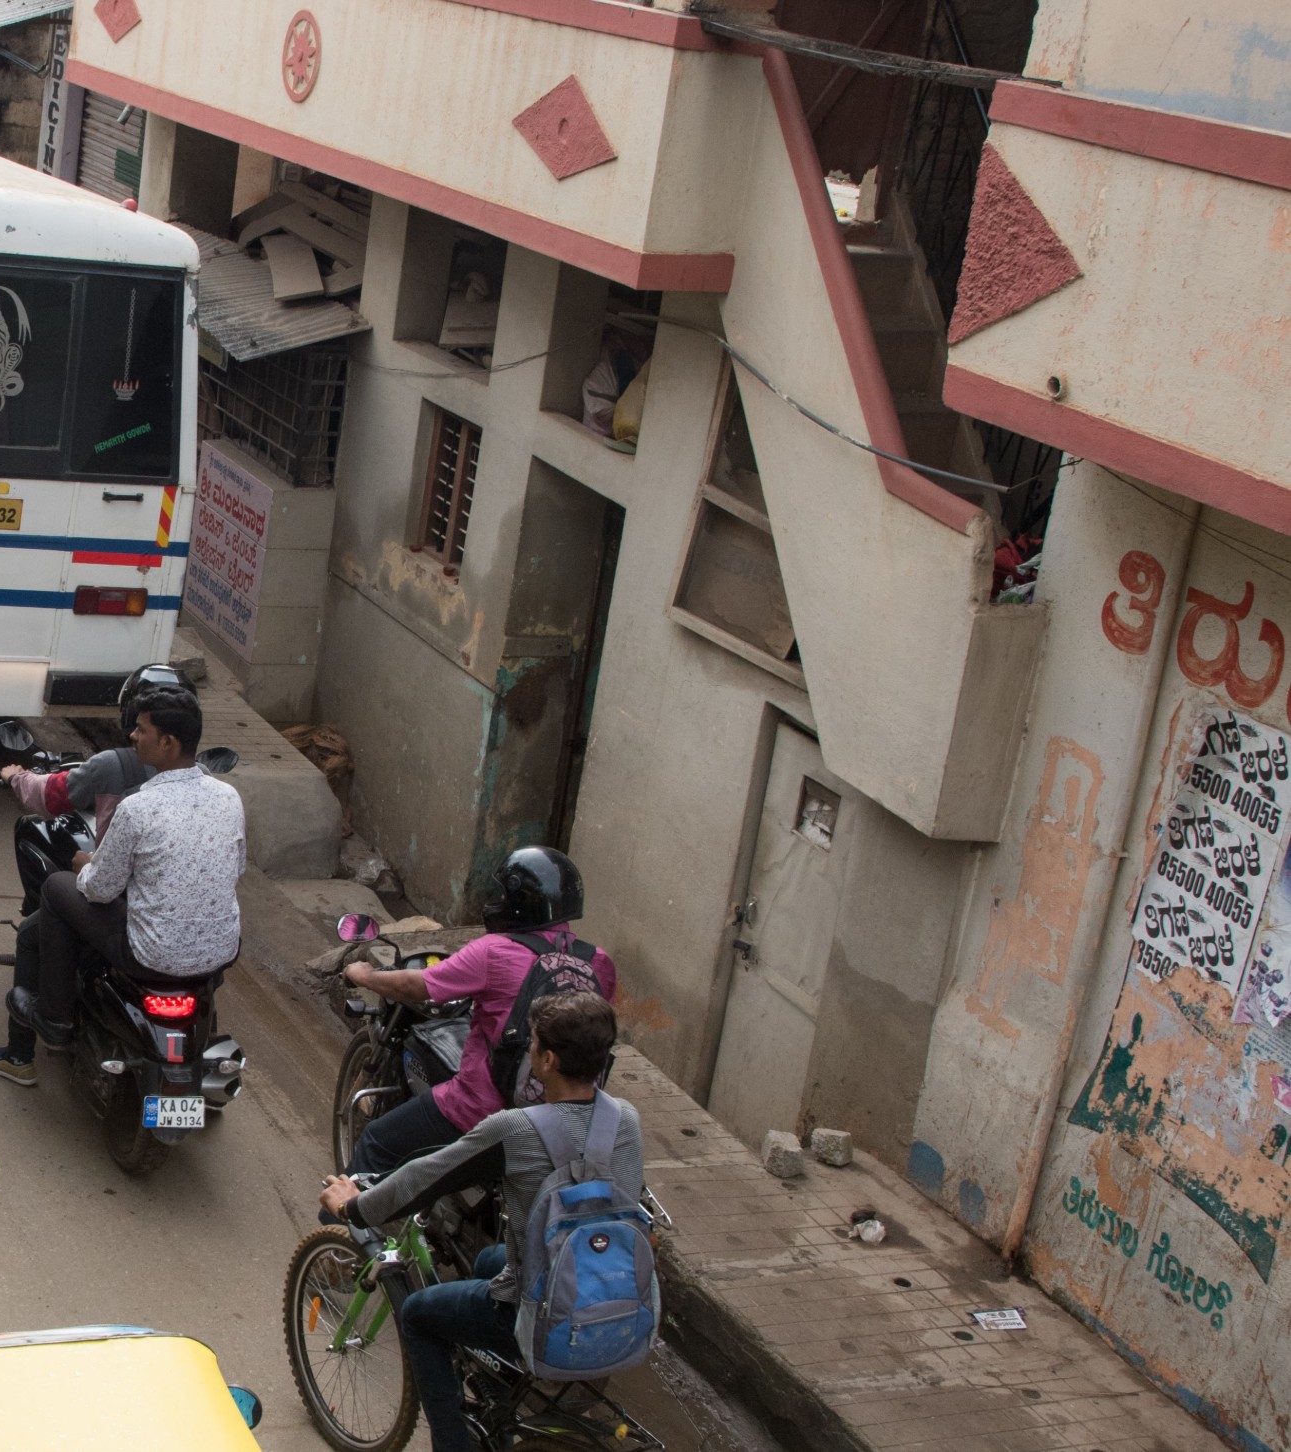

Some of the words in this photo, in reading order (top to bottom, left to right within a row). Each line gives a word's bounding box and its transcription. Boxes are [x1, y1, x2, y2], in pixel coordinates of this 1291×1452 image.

[126, 422, 152, 439] GOWDA
[1101, 551, 1291, 726] ತಿರು
[1197, 710, 1241, 758] ಗಣೆ
[1183, 764, 1232, 804] 5500
[1230, 786, 1282, 834] 40055
[1157, 851, 1205, 898] 85500
[1204, 881, 1254, 929] 40055
[160, 1099, 176, 1112] KA
[180, 1099, 197, 1112] 04
[160, 1116, 172, 1126] JW
[176, 1116, 202, 1126] 9134
[473, 1348, 501, 1372] HERO
